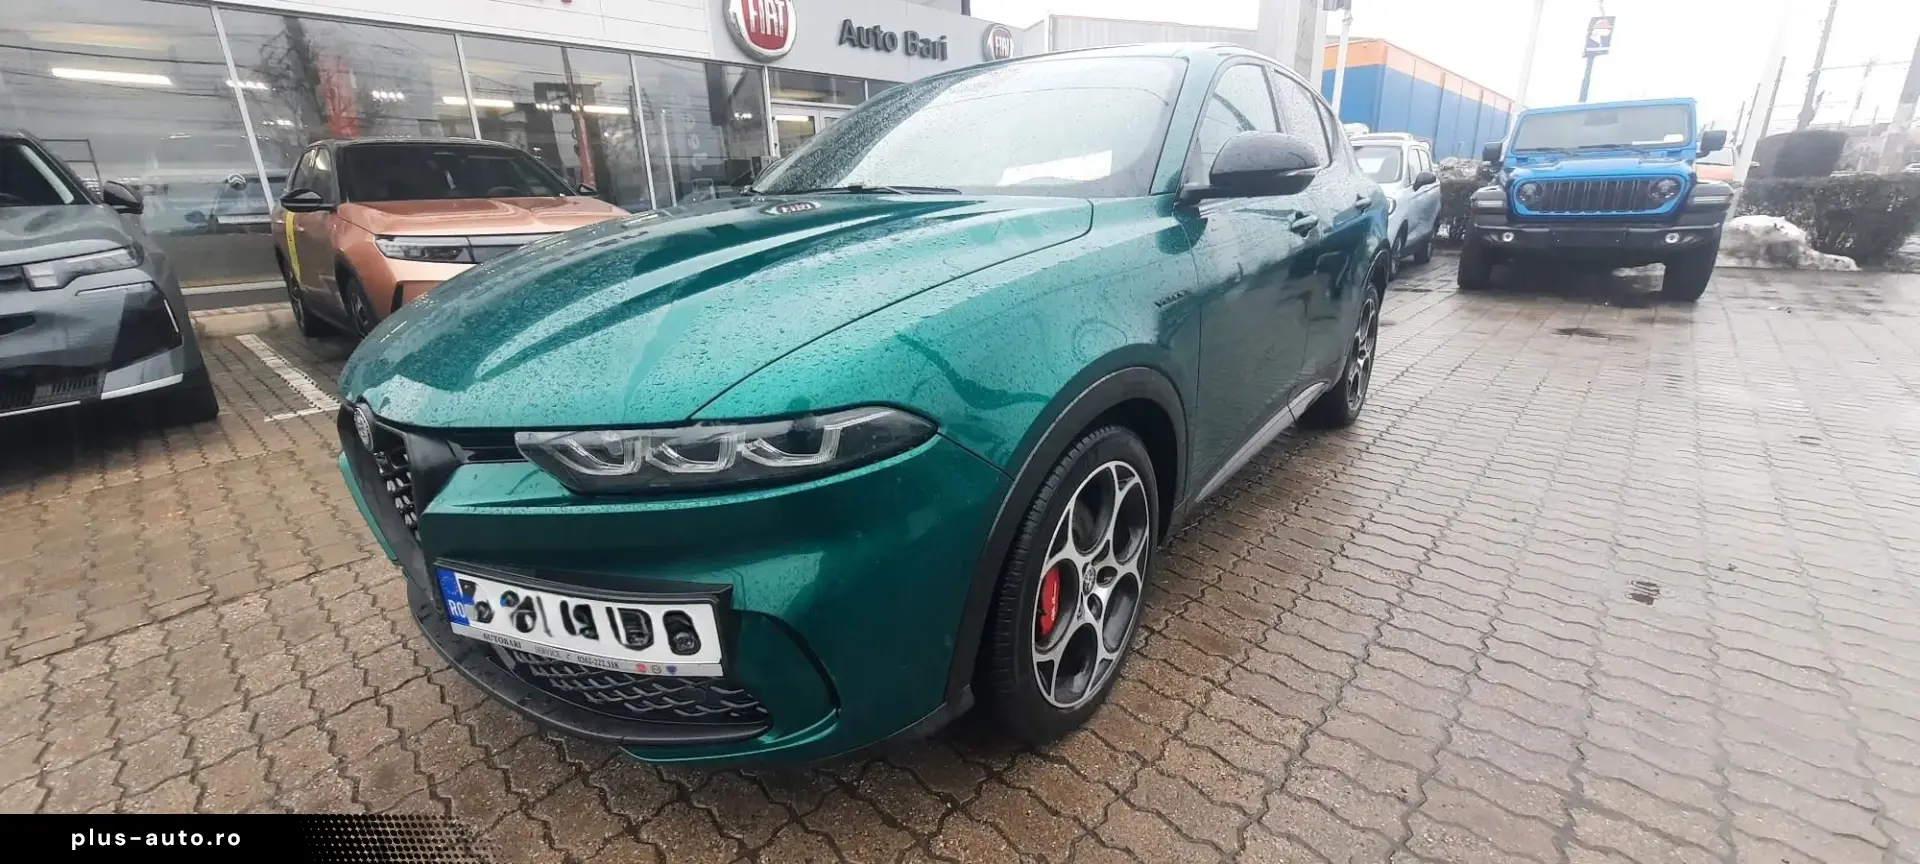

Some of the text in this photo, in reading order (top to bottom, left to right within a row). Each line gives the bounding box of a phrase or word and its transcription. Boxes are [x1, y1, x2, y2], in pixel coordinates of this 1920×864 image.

[747, 0, 786, 38] FIAT
[838, 19, 948, 61] Auto Bari
[448, 600, 466, 618] RO
[483, 633, 522, 649] AUTOBARI
